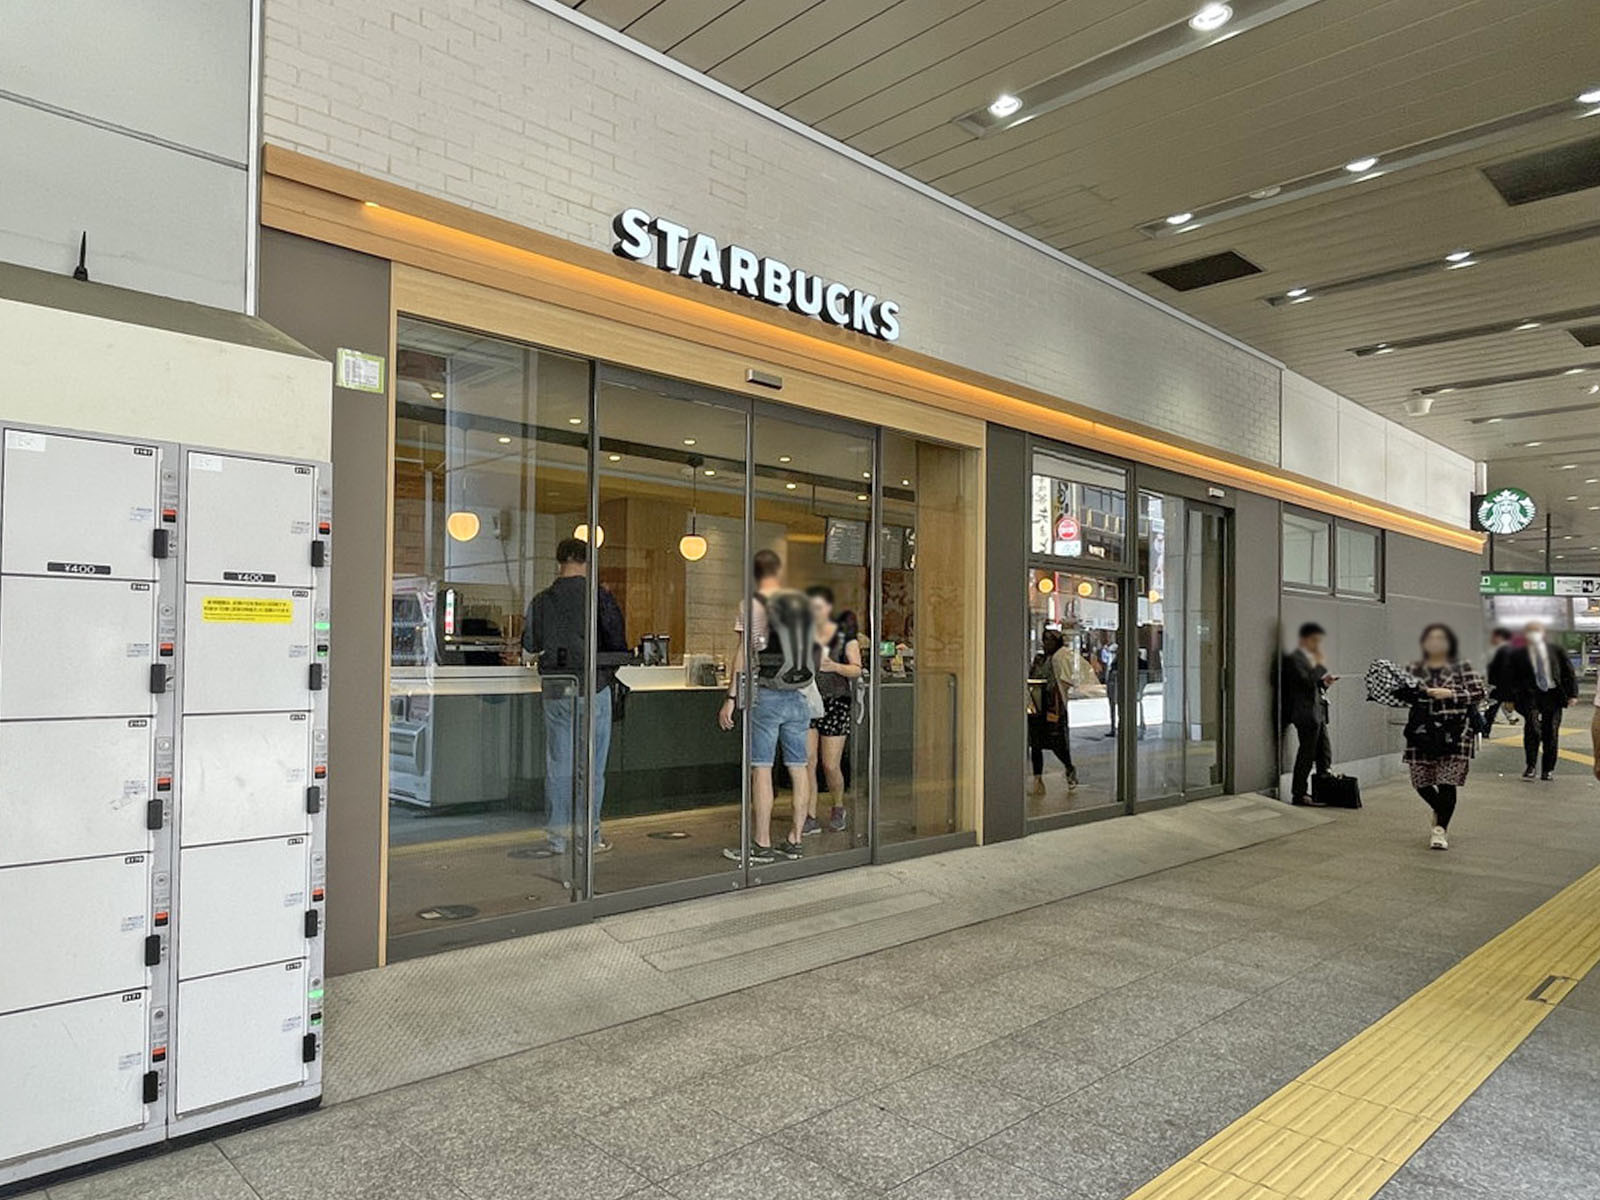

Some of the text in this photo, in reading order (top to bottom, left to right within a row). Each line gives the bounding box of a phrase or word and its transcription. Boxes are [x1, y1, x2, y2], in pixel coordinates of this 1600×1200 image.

[612, 208, 900, 341] STARBUCKS
[64, 564, 96, 575] ¥400
[238, 572, 263, 582] ¥400
